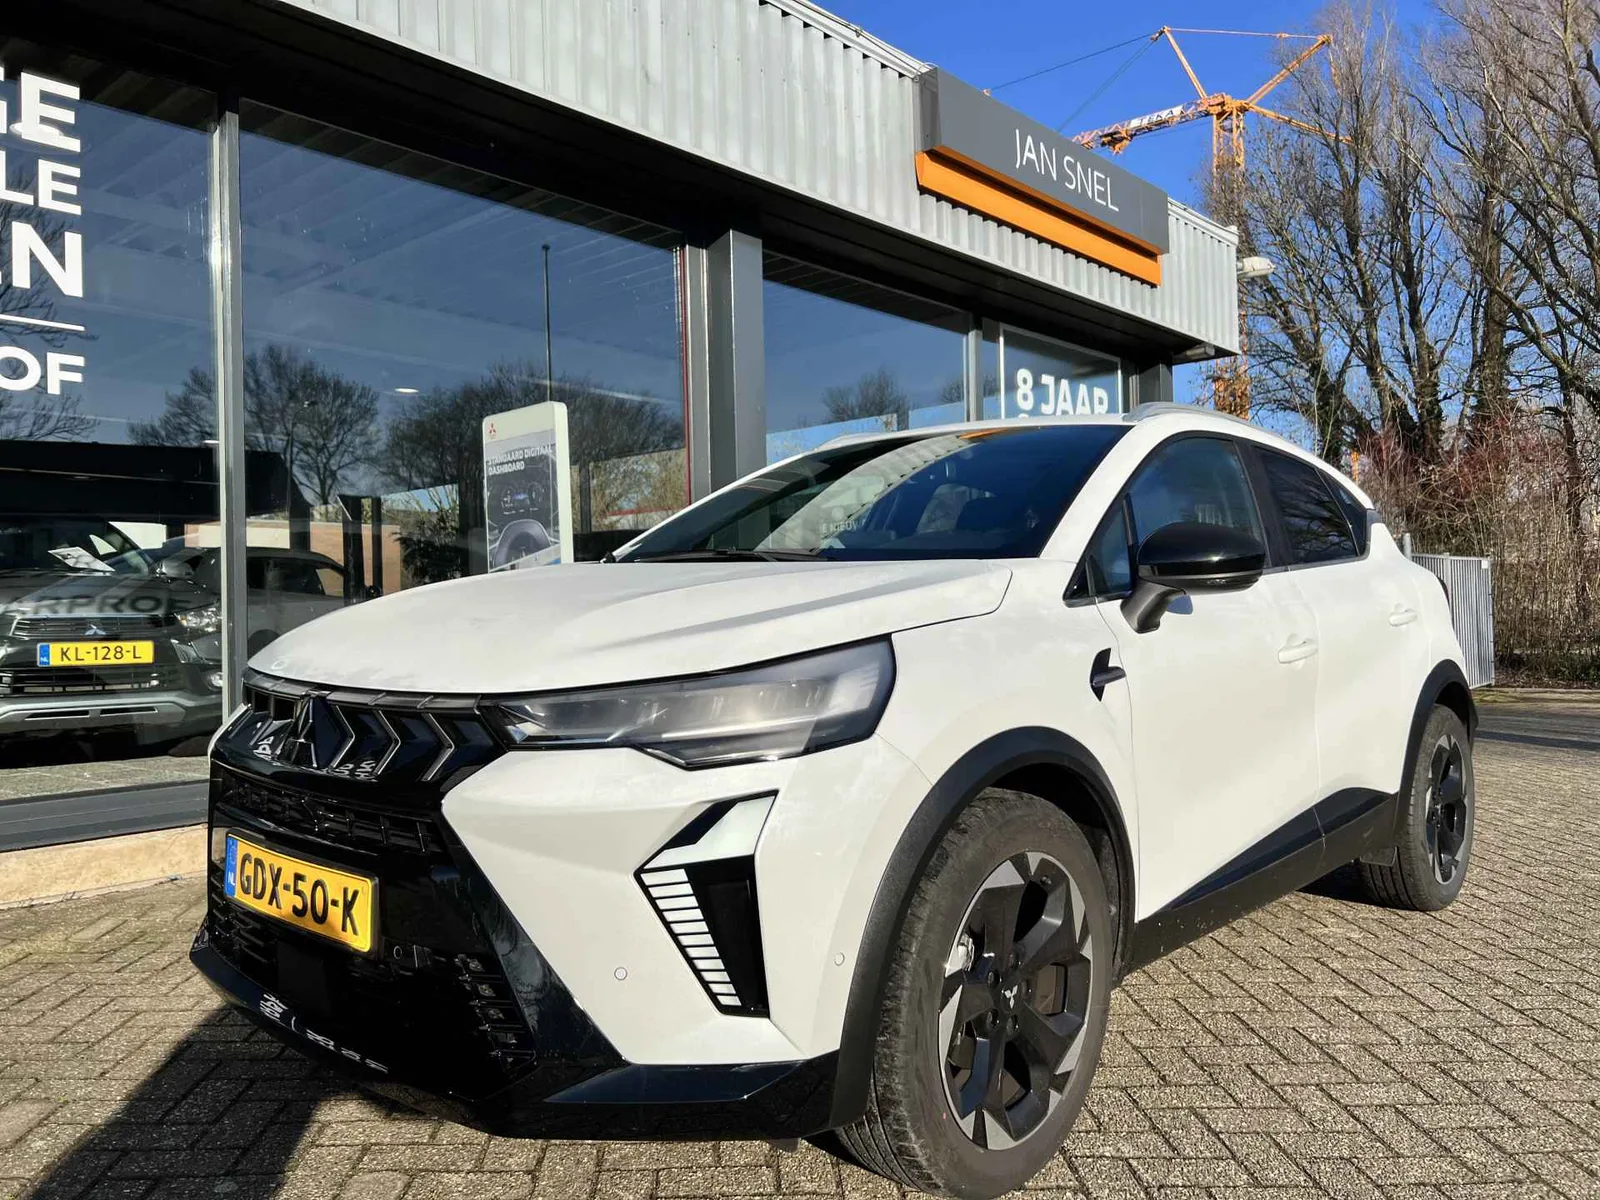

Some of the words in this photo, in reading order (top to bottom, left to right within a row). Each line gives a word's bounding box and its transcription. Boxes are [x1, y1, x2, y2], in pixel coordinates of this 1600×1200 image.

[0, 66, 80, 153] E
[1015, 128, 1057, 181] JAN
[1063, 155, 1120, 212] SNEL
[1016, 368, 1034, 411] 8
[1041, 373, 1109, 416] JAAR
[488, 460, 525, 476] DASHBOARD
[60, 645, 142, 662] KL-128-L
[228, 871, 236, 886] NL
[239, 852, 360, 936] GDX-50-K
